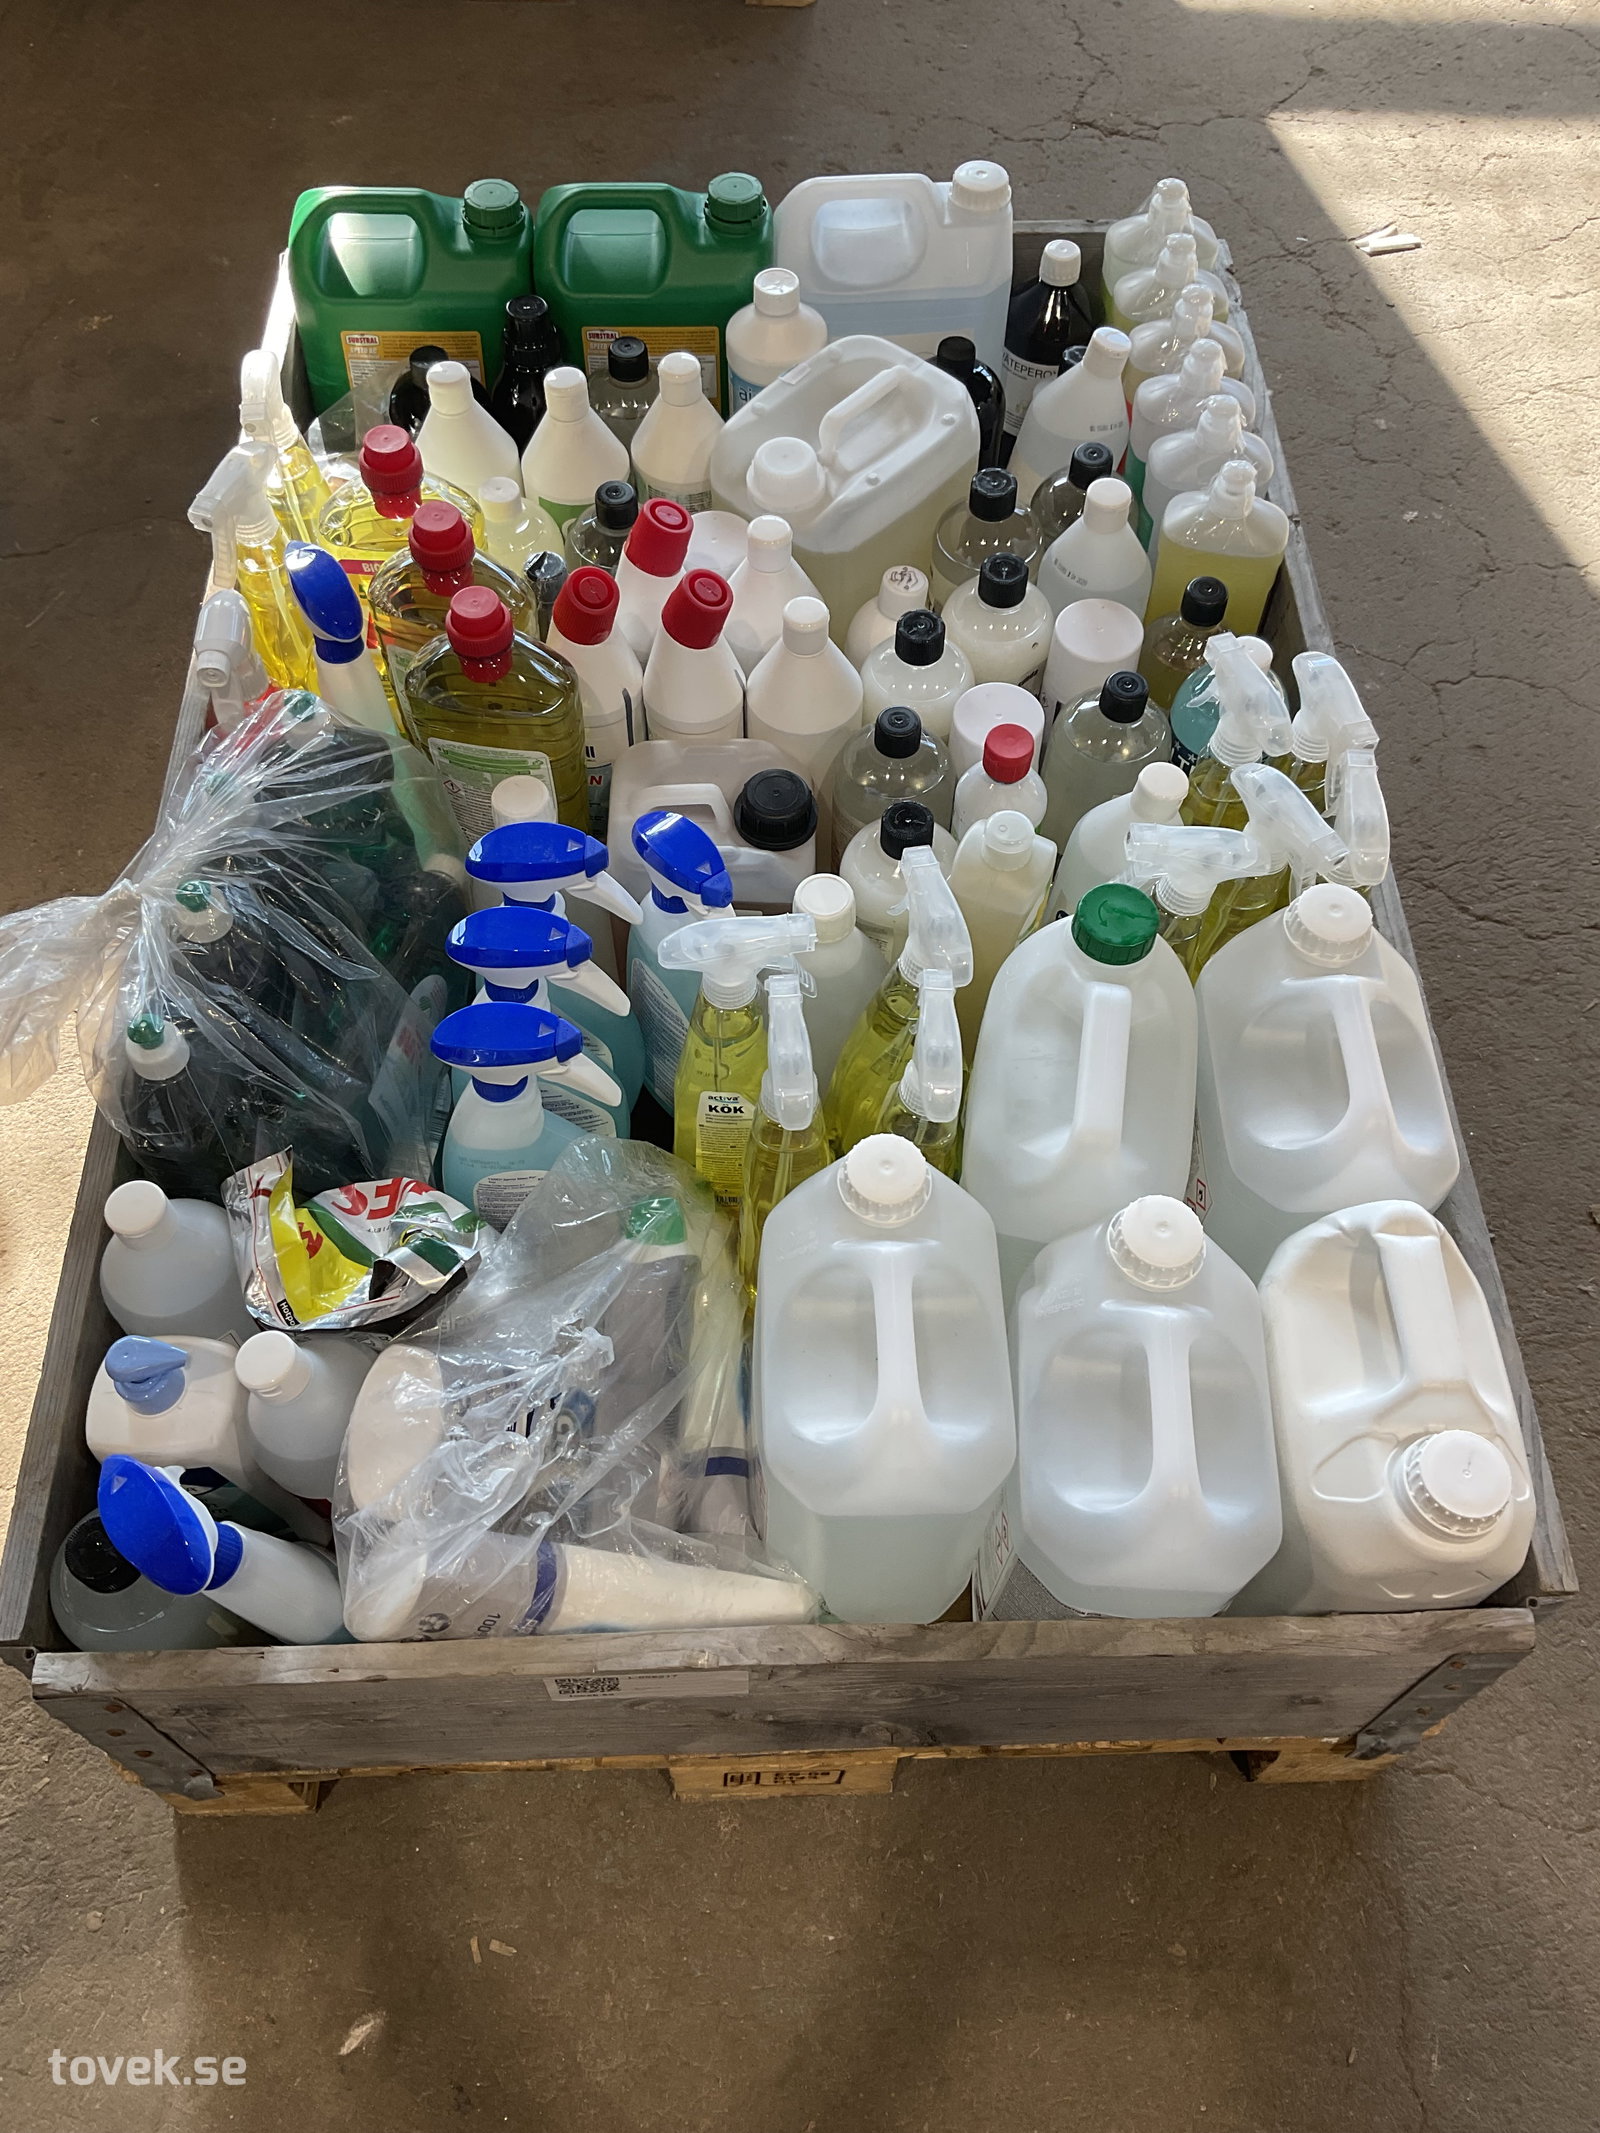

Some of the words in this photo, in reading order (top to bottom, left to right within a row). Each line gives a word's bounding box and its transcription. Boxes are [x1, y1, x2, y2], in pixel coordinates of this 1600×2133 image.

[347, 336, 378, 345] SUBSTRAL
[708, 1103, 744, 1114] KÖK
[279, 1301, 296, 1326] Hotpo
